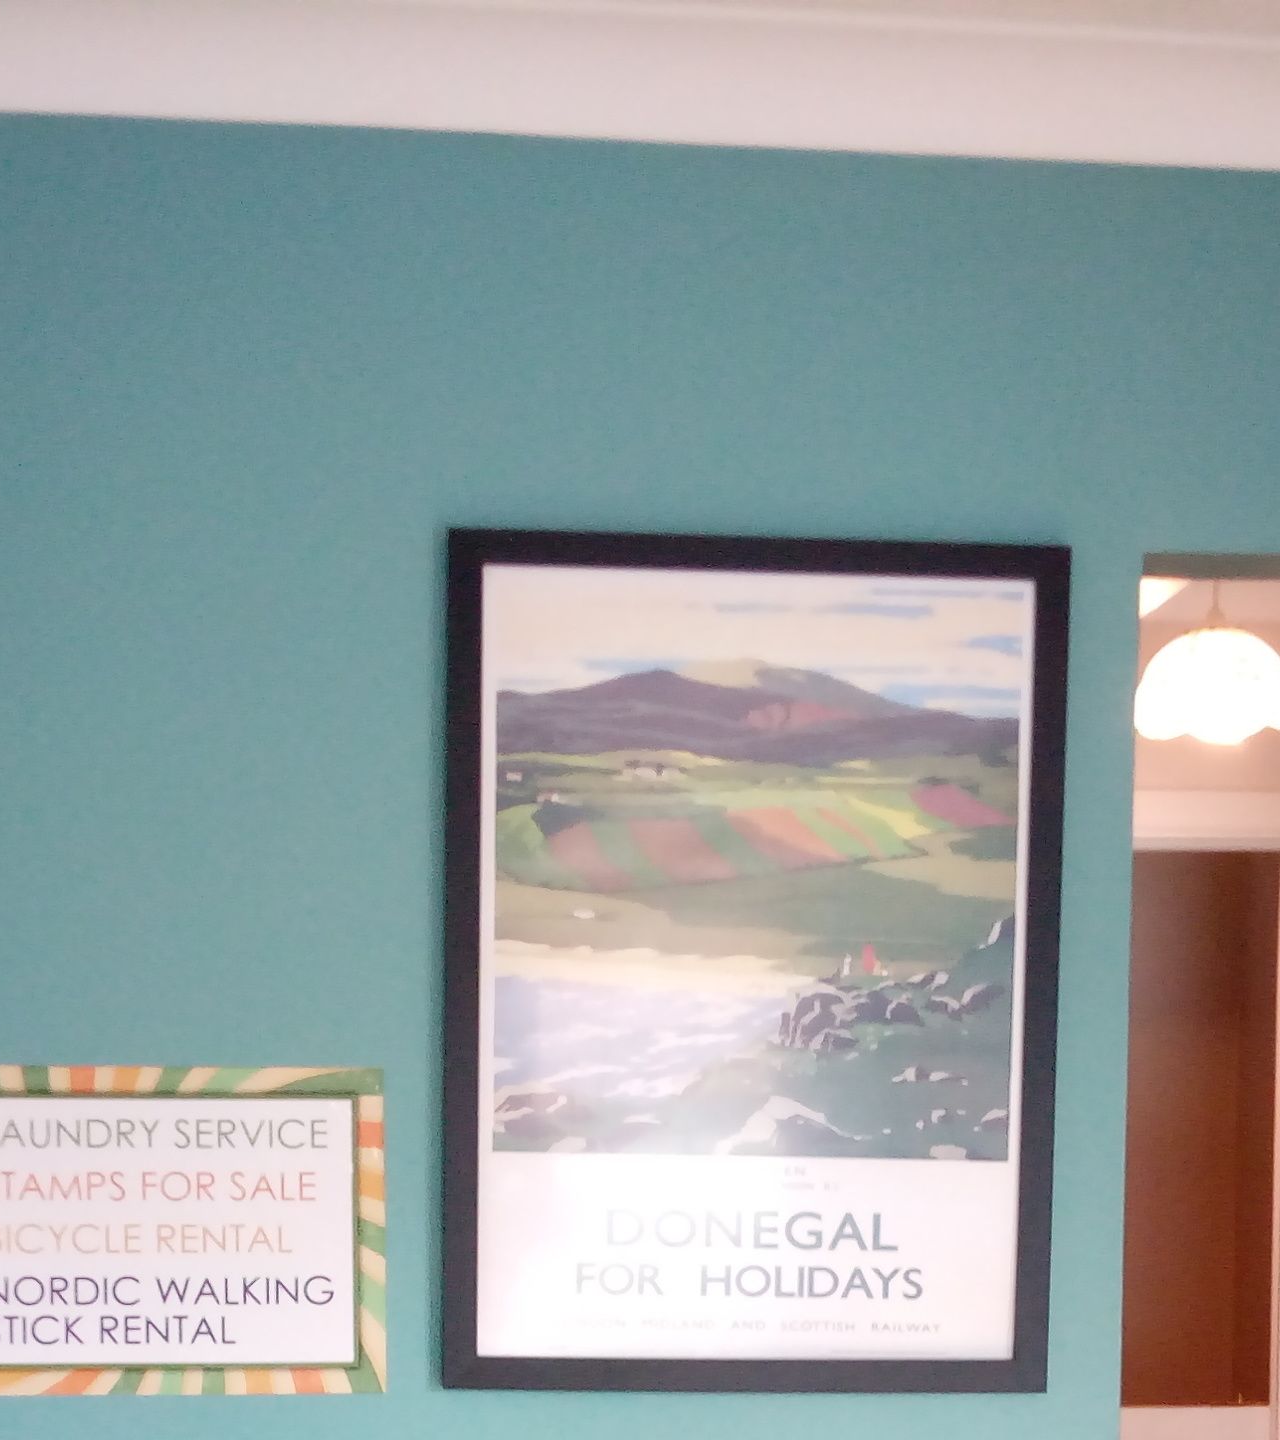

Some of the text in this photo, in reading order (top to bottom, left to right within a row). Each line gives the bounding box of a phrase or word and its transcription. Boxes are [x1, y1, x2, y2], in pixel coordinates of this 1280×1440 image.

[173, 1119, 330, 1150] SERVICE
[141, 1172, 218, 1201] FOR
[229, 1172, 317, 1202] SALE
[156, 1225, 293, 1255] RENTAL
[606, 1208, 899, 1253] DONEGAL
[155, 1275, 334, 1306] WALKING
[575, 1262, 924, 1300] FOR HOLIDAYS
[100, 1316, 236, 1346] RENTAL
